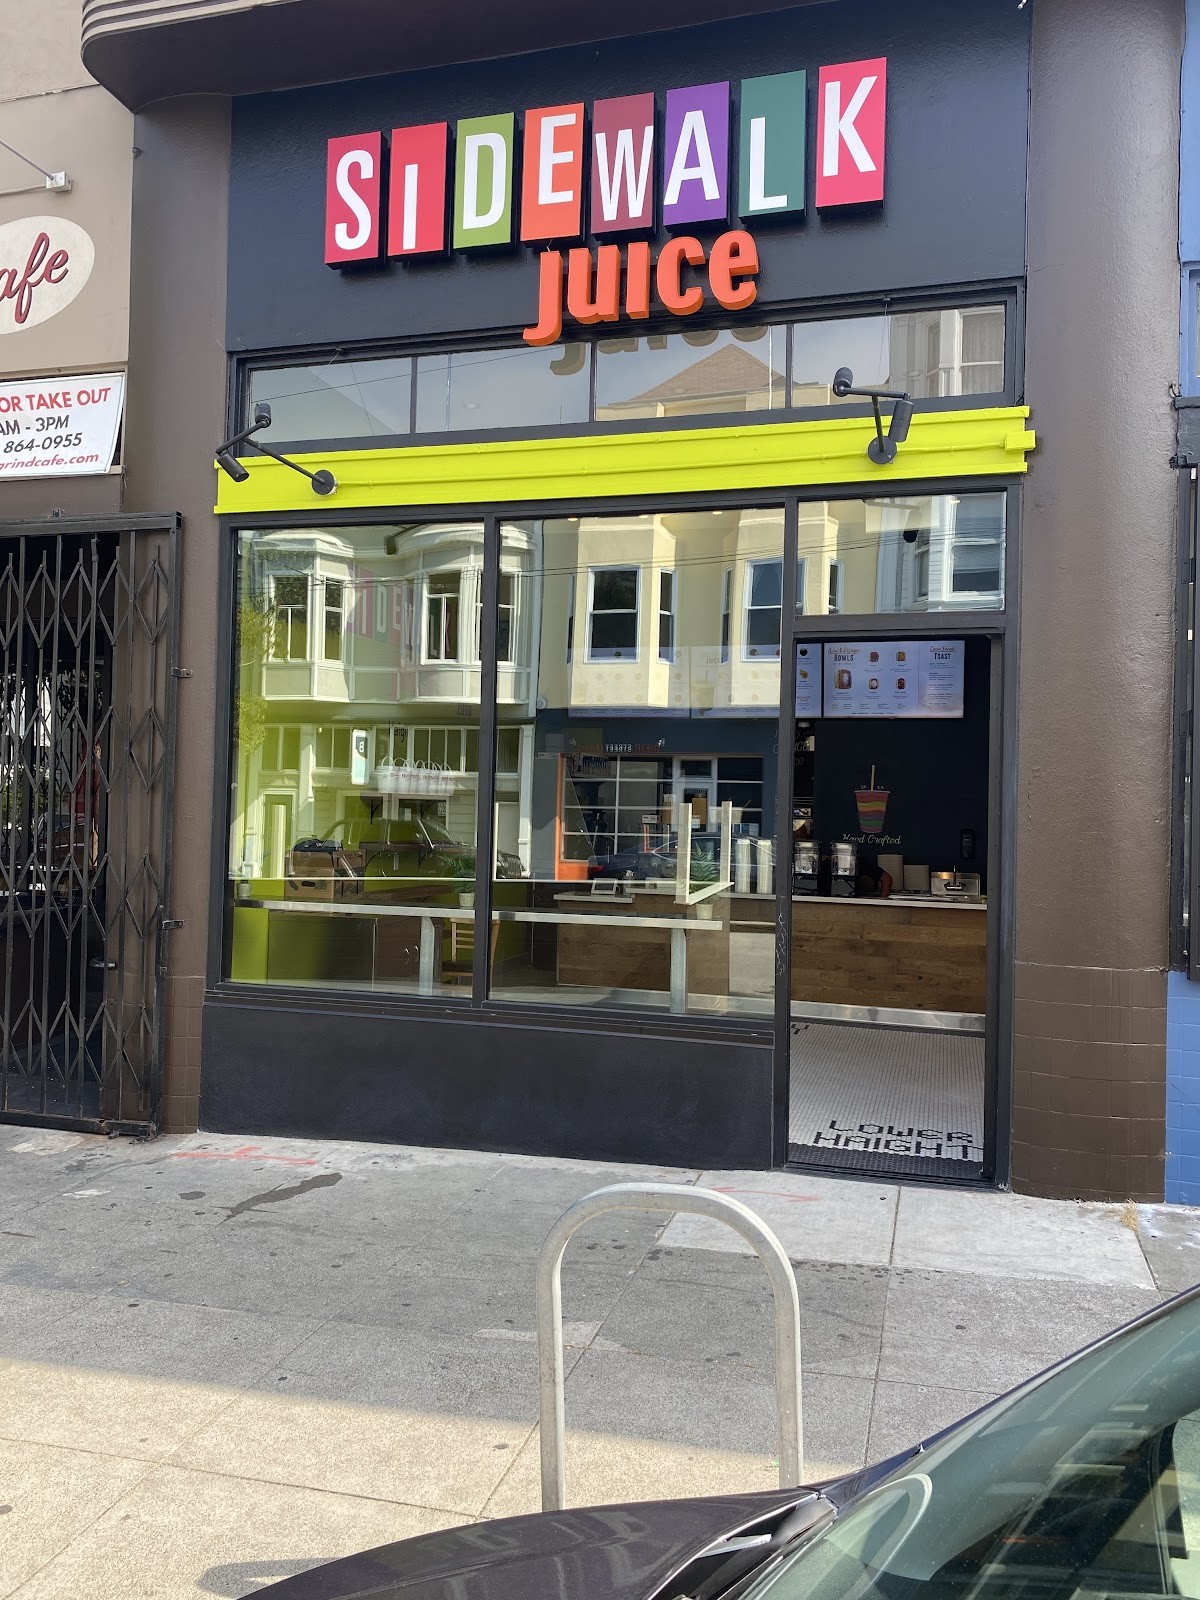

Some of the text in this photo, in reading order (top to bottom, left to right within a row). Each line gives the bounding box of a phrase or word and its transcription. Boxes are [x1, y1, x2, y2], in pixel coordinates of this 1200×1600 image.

[333, 74, 879, 251] SIDEWALK
[522, 229, 759, 346] juice
[25, 391, 72, 411] TAKE
[76, 387, 111, 406] OUT
[35, 414, 69, 433] 3PM
[3, 432, 83, 454] 864-0955
[834, 654, 854, 662] BOWLS
[934, 652, 951, 660] TOAST
[842, 833, 902, 847] Hand Crafted
[828, 1119, 973, 1144] LOWER
[813, 1131, 984, 1159] HAIGHT
